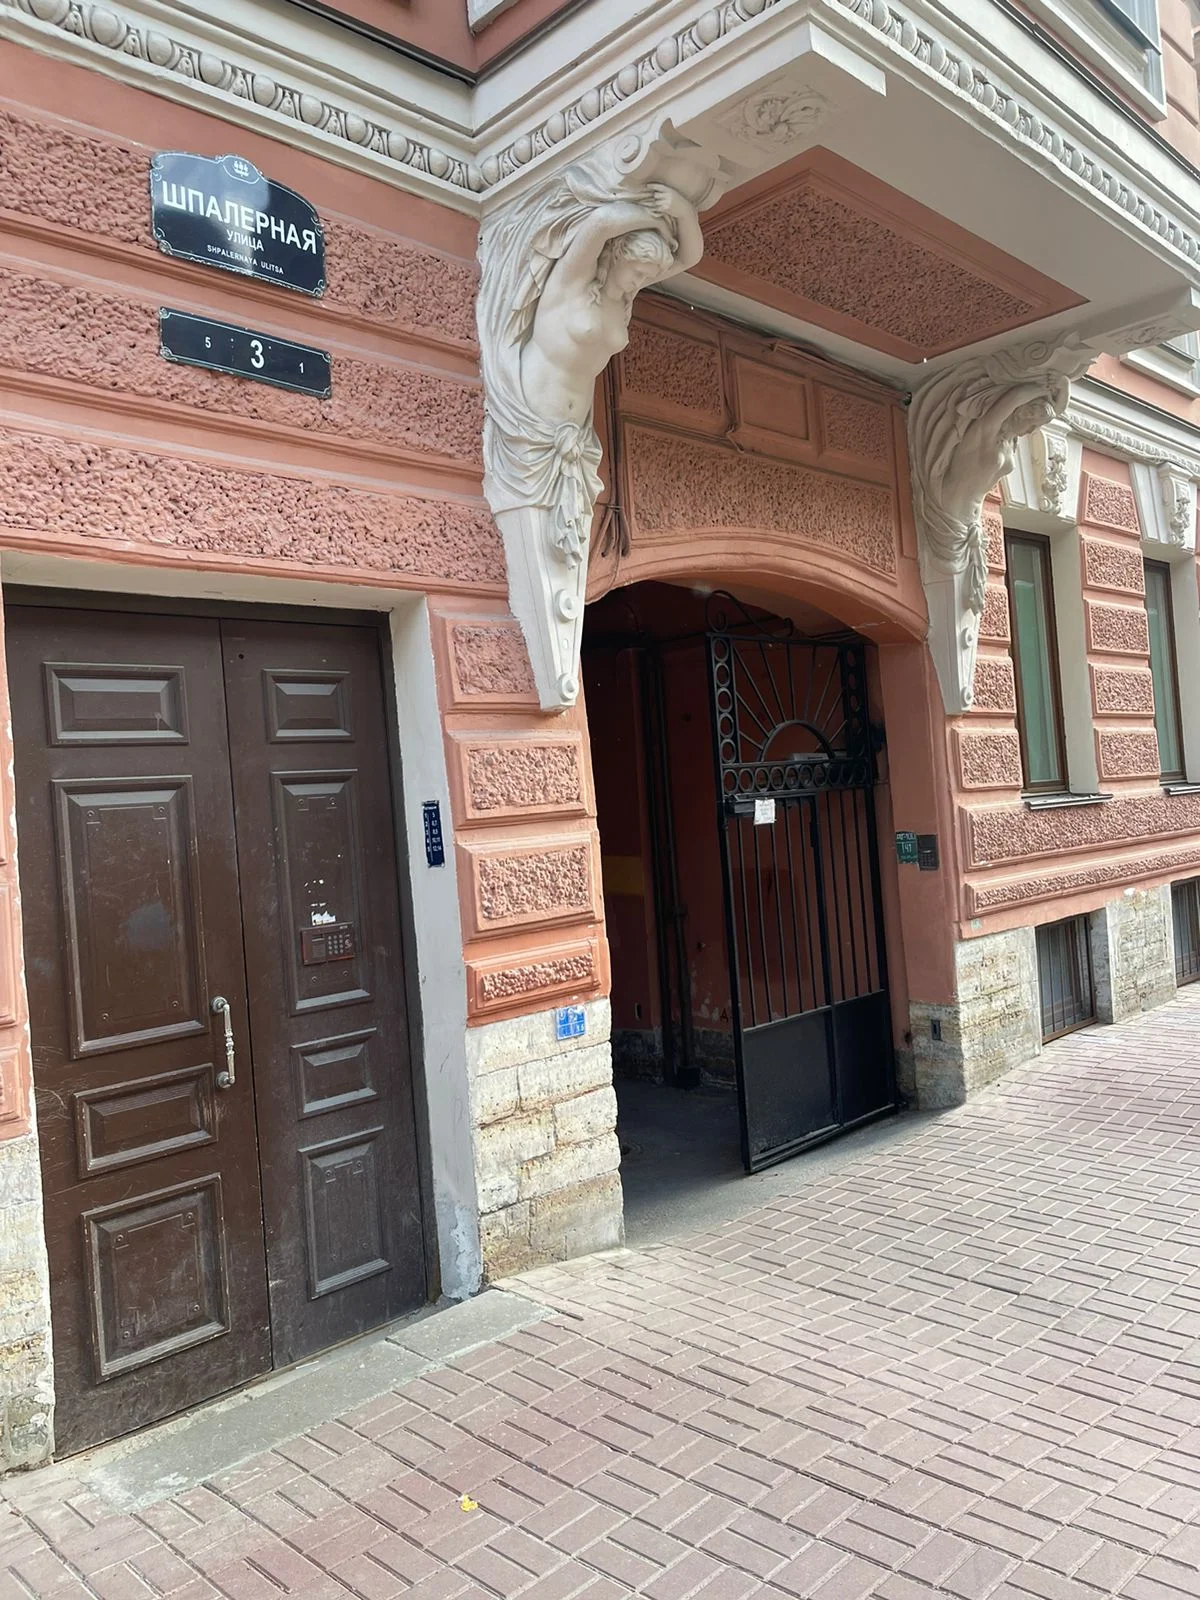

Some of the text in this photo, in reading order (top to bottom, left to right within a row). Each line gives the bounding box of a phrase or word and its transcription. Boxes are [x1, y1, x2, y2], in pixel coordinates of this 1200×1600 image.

[162, 180, 317, 254] ШПАЛЕРНАЯ
[226, 229, 264, 252] УЛИЦА
[206, 244, 284, 275] SHPALERNAYA ULITSA
[204, 336, 212, 349] 5
[250, 339, 265, 369] 3
[299, 362, 304, 374] 1
